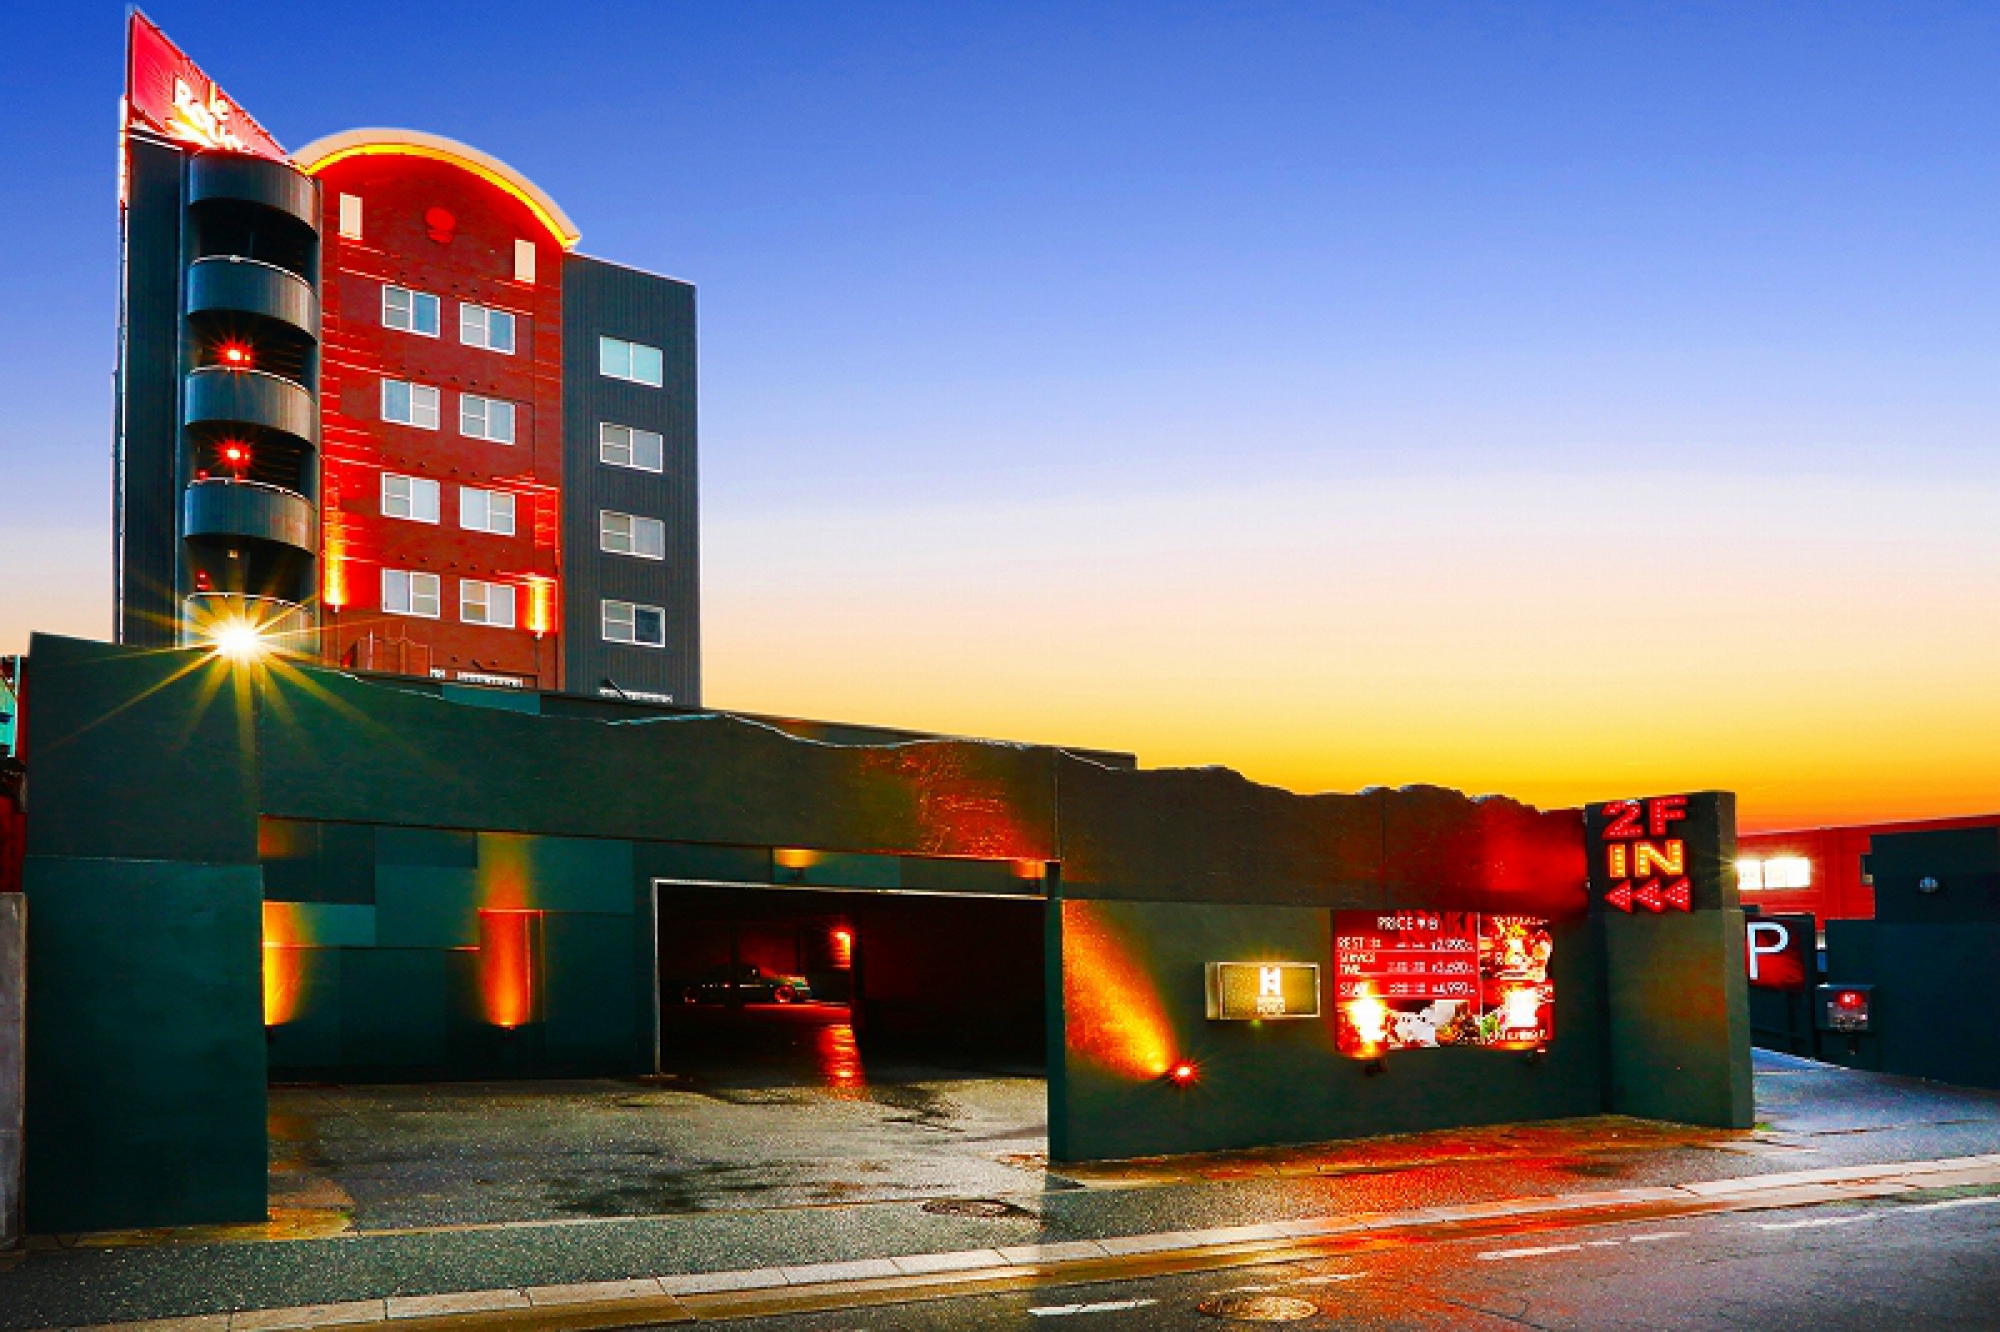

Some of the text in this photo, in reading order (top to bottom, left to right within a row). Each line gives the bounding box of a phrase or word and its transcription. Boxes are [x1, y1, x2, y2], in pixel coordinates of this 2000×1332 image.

[1602, 795, 1689, 838] 2F
[1608, 839, 1684, 878] IN
[1377, 916, 1414, 931] PRICE
[1747, 921, 1790, 980] P
